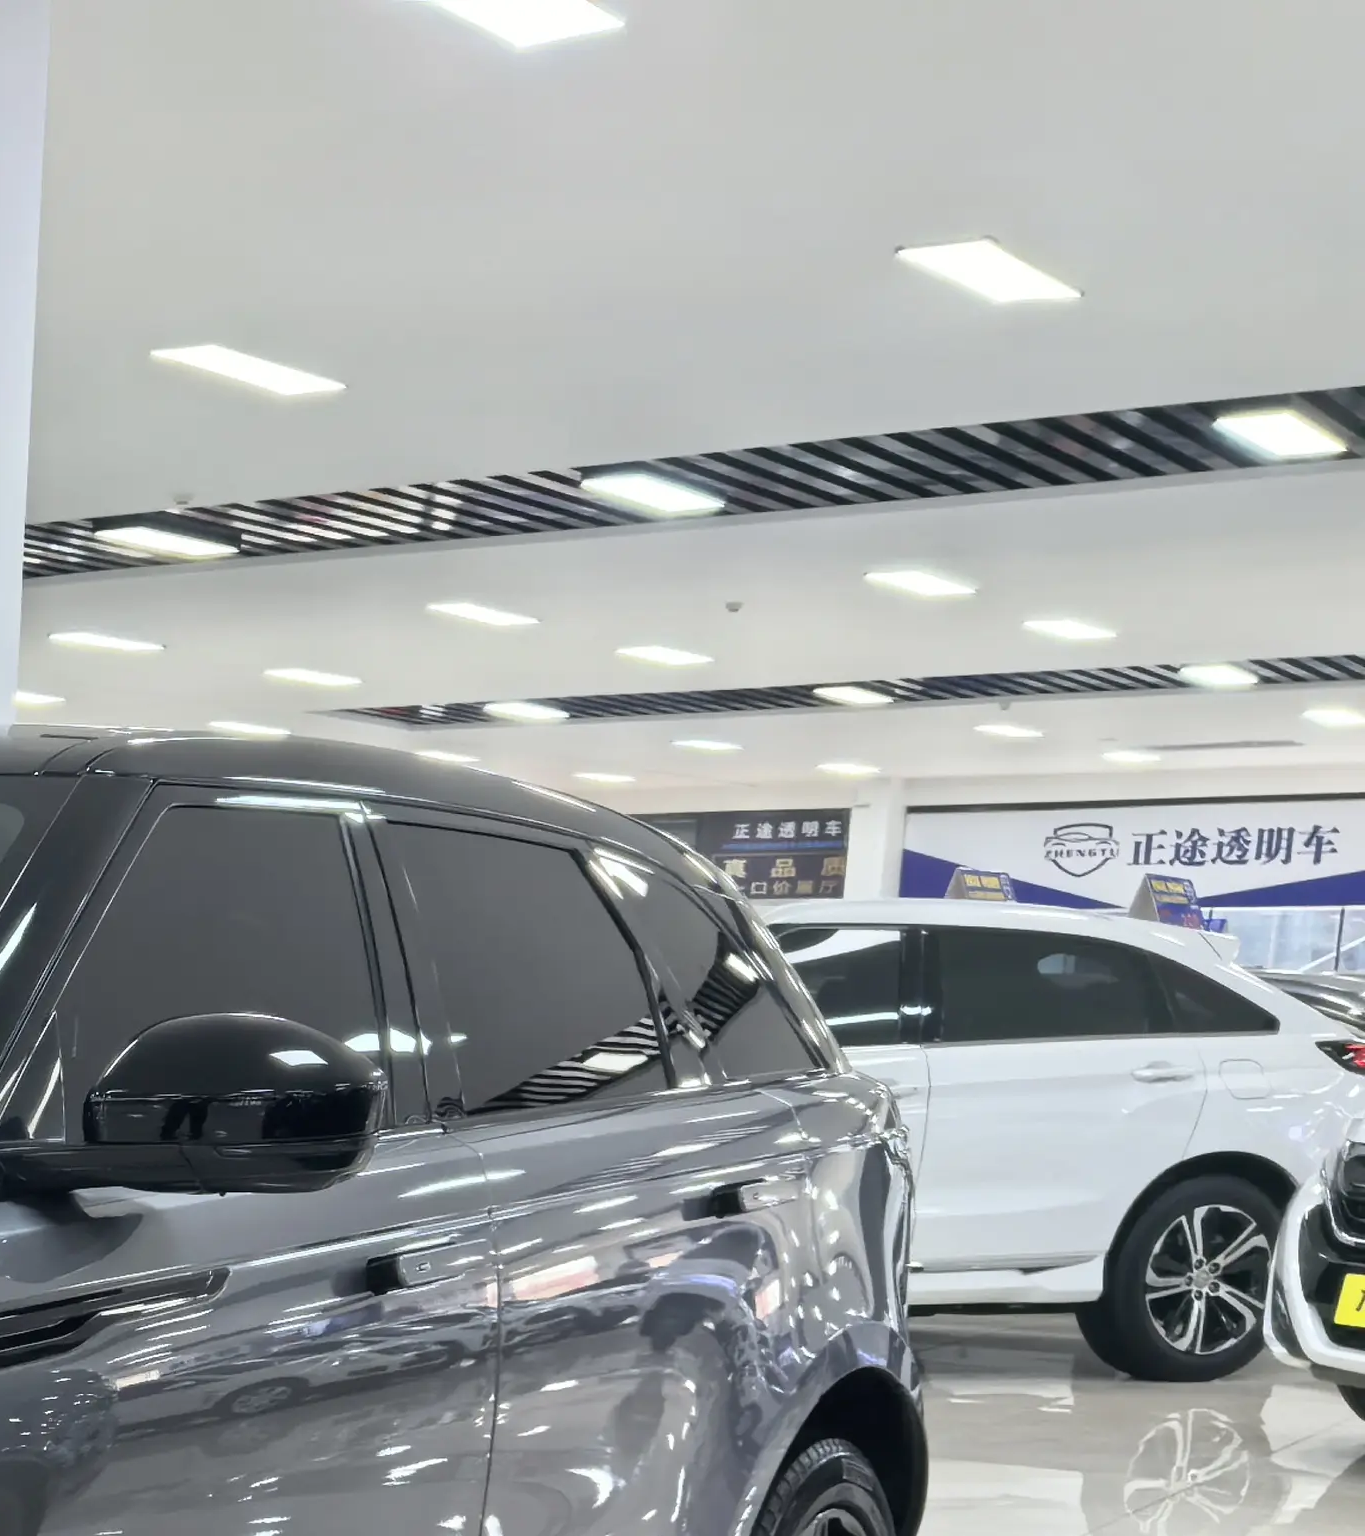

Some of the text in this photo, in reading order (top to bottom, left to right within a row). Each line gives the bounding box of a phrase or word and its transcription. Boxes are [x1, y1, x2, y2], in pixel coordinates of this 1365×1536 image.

[732, 820, 842, 839] 正途透明车
[1127, 825, 1340, 866] 正途透明车
